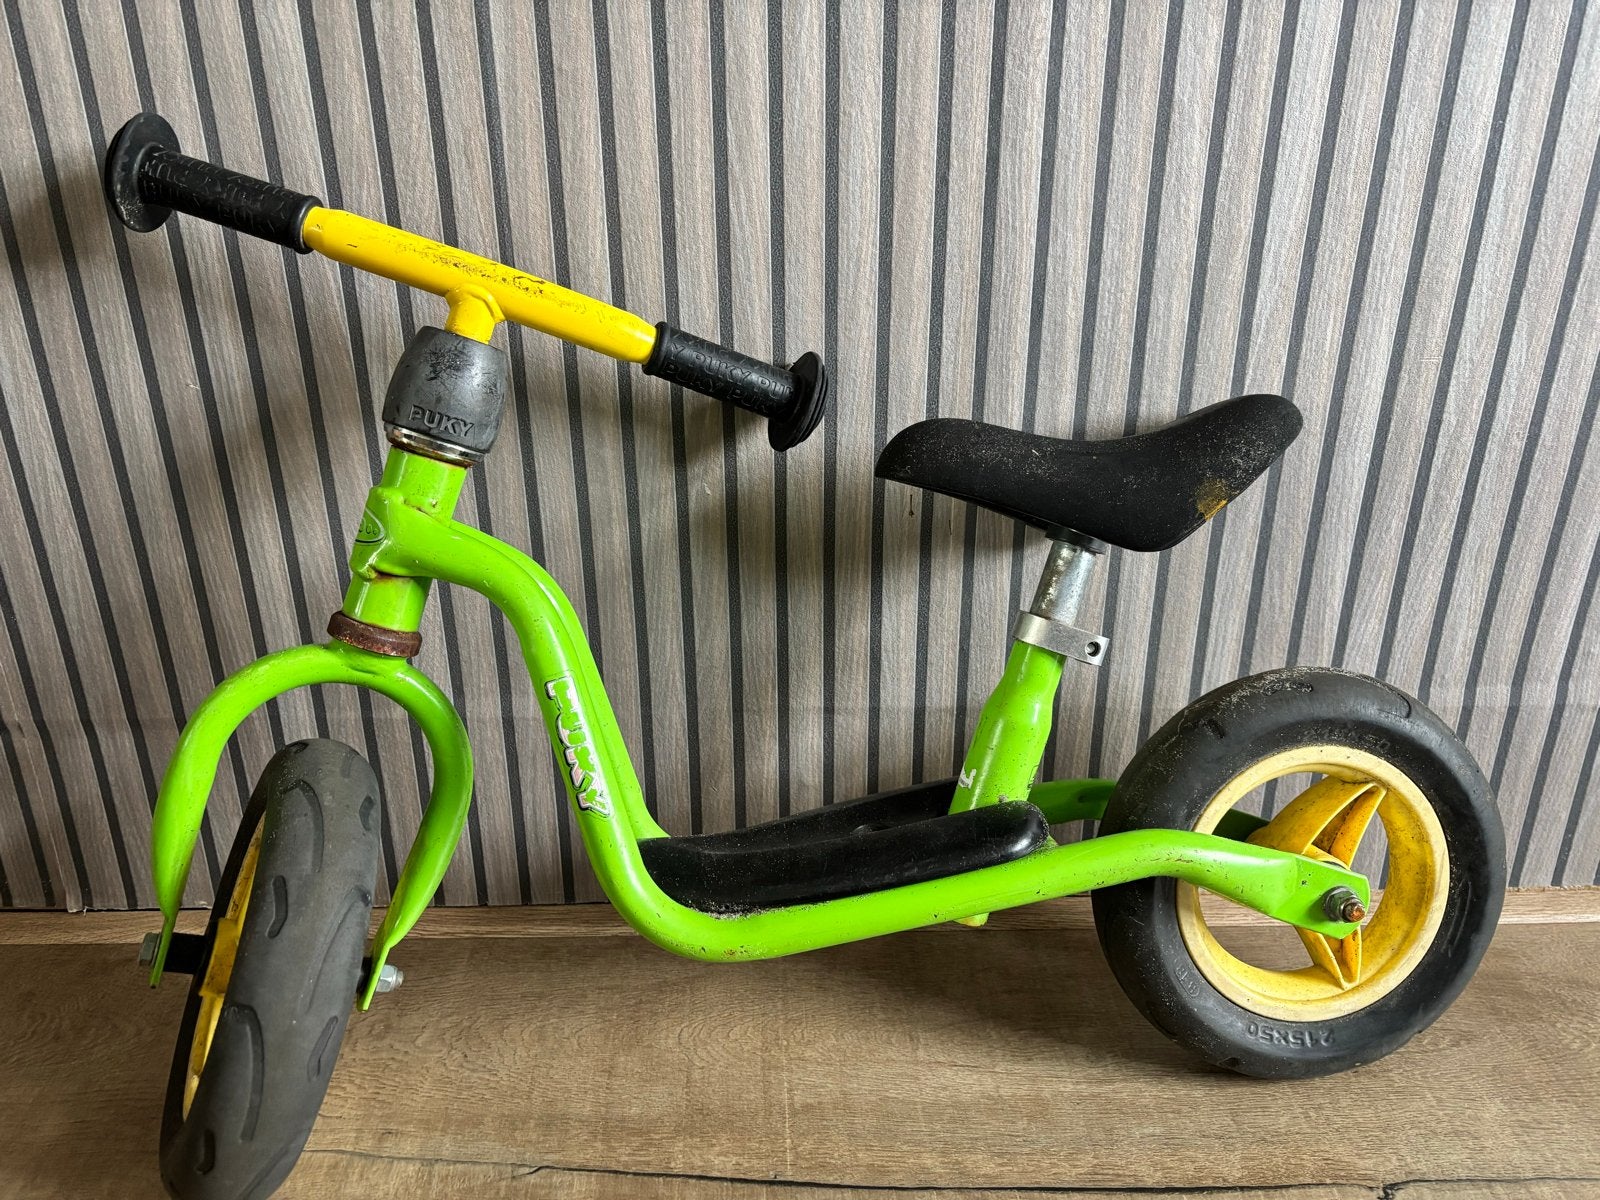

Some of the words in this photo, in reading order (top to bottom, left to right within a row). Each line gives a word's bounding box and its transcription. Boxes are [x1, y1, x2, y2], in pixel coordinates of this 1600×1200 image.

[691, 351, 752, 386] PUKY
[408, 404, 475, 438] PUKY
[544, 676, 610, 818] PUKY
